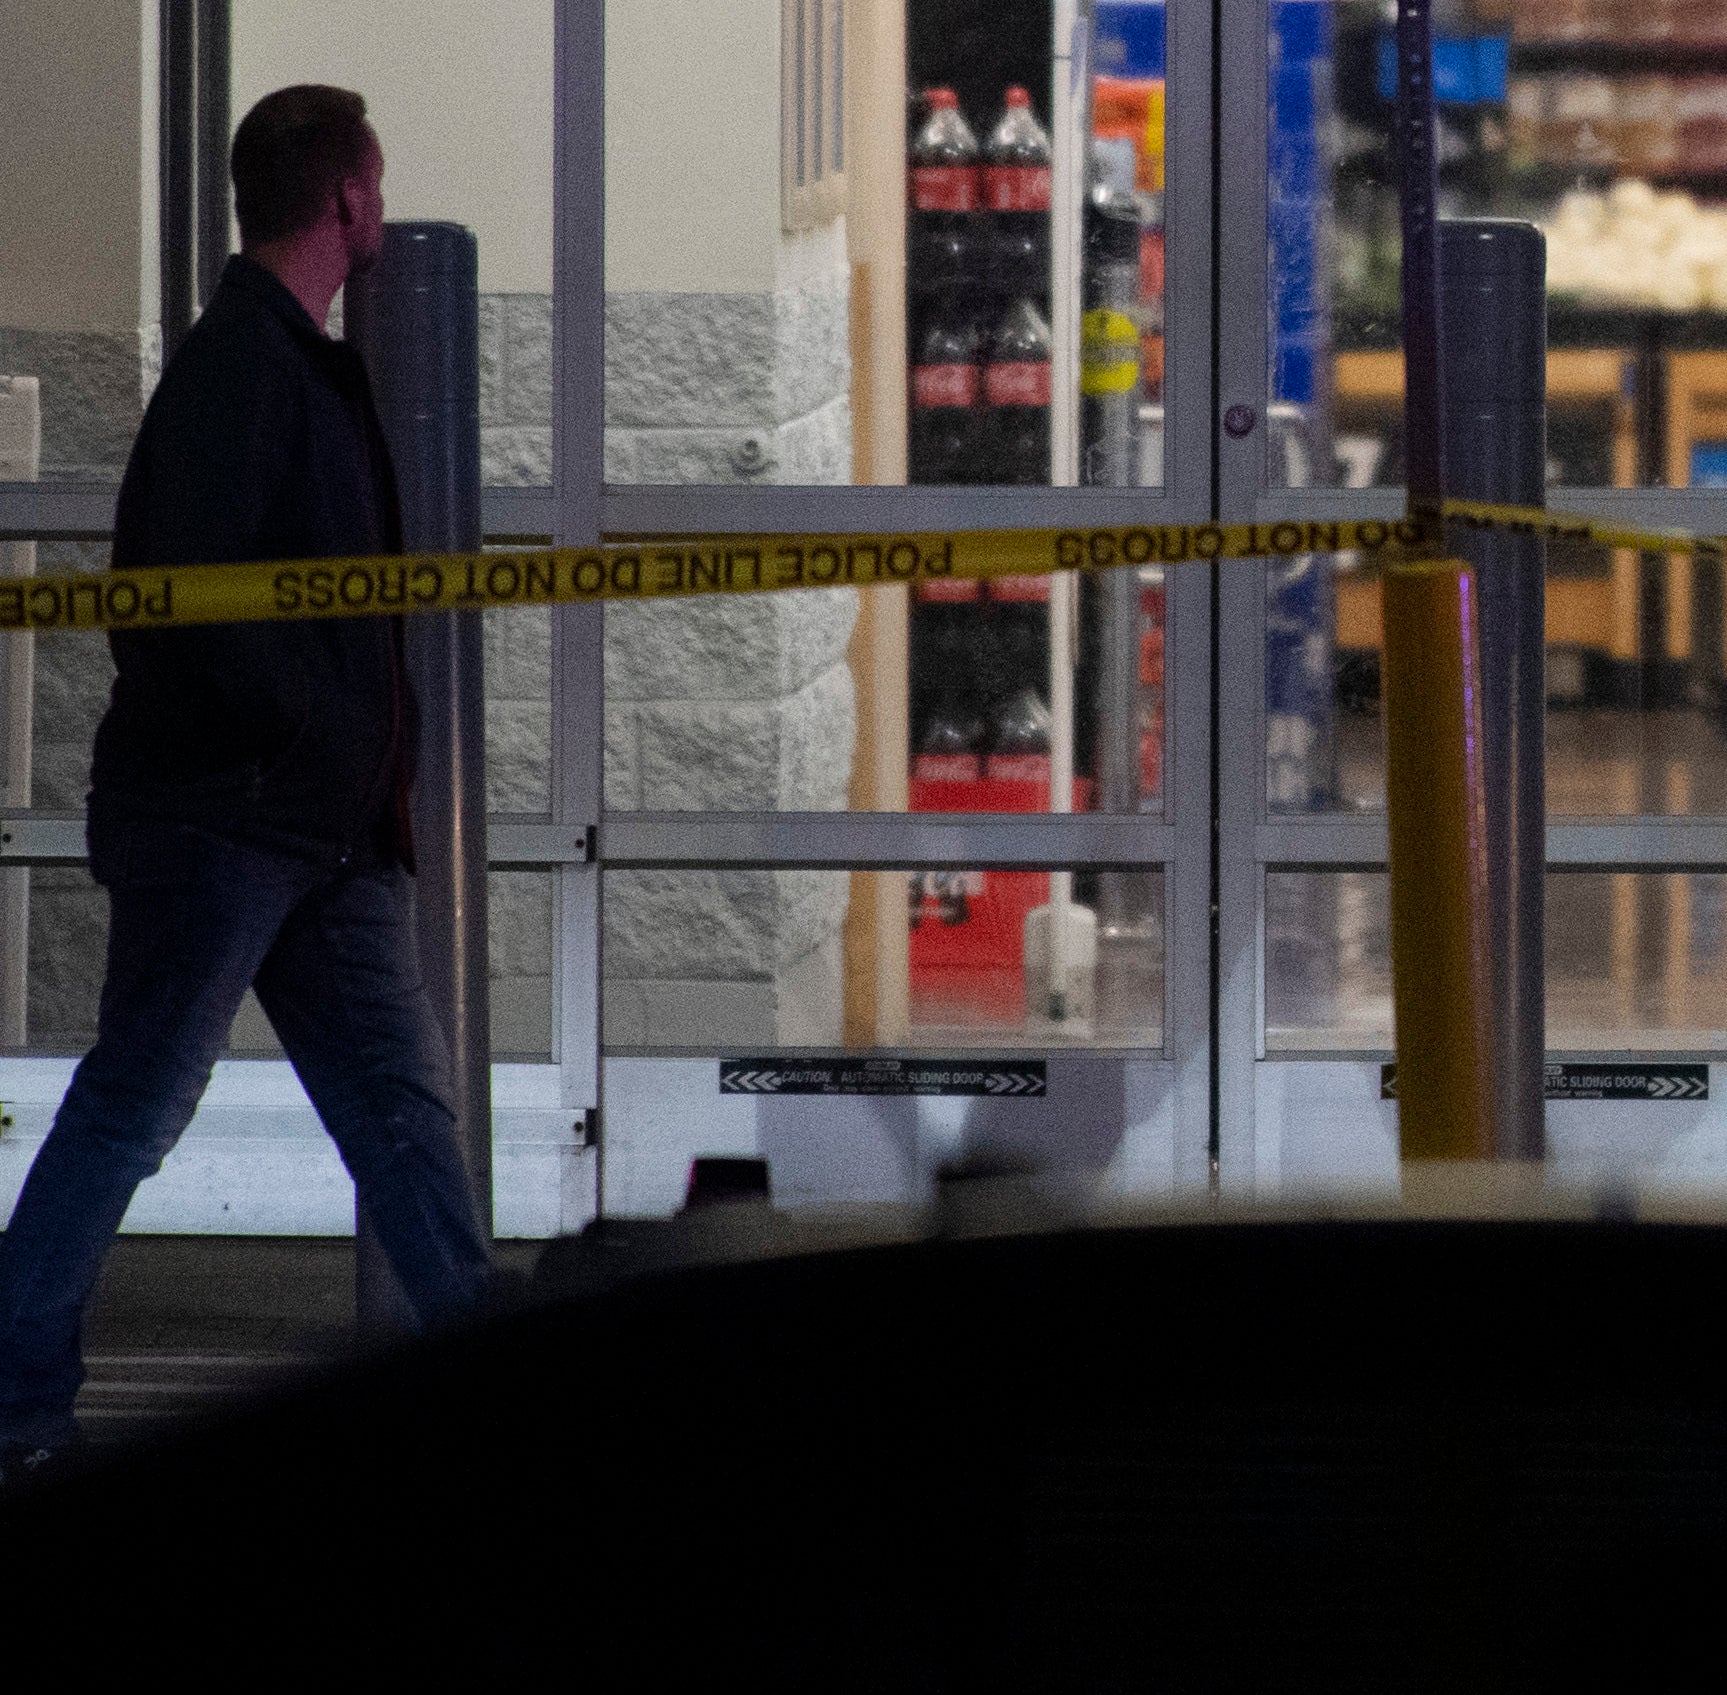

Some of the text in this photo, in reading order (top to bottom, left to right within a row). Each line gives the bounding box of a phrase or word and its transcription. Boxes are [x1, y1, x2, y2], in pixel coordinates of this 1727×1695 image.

[1245, 520, 1339, 556] NOT
[458, 559, 556, 603] NOT
[572, 553, 641, 596] DO
[660, 546, 762, 591] LINE
[778, 540, 954, 587] POLICE
[0, 575, 173, 626] POLICE
[274, 563, 445, 612] CROSS
[1614, 1077, 1647, 1088] DOOR
